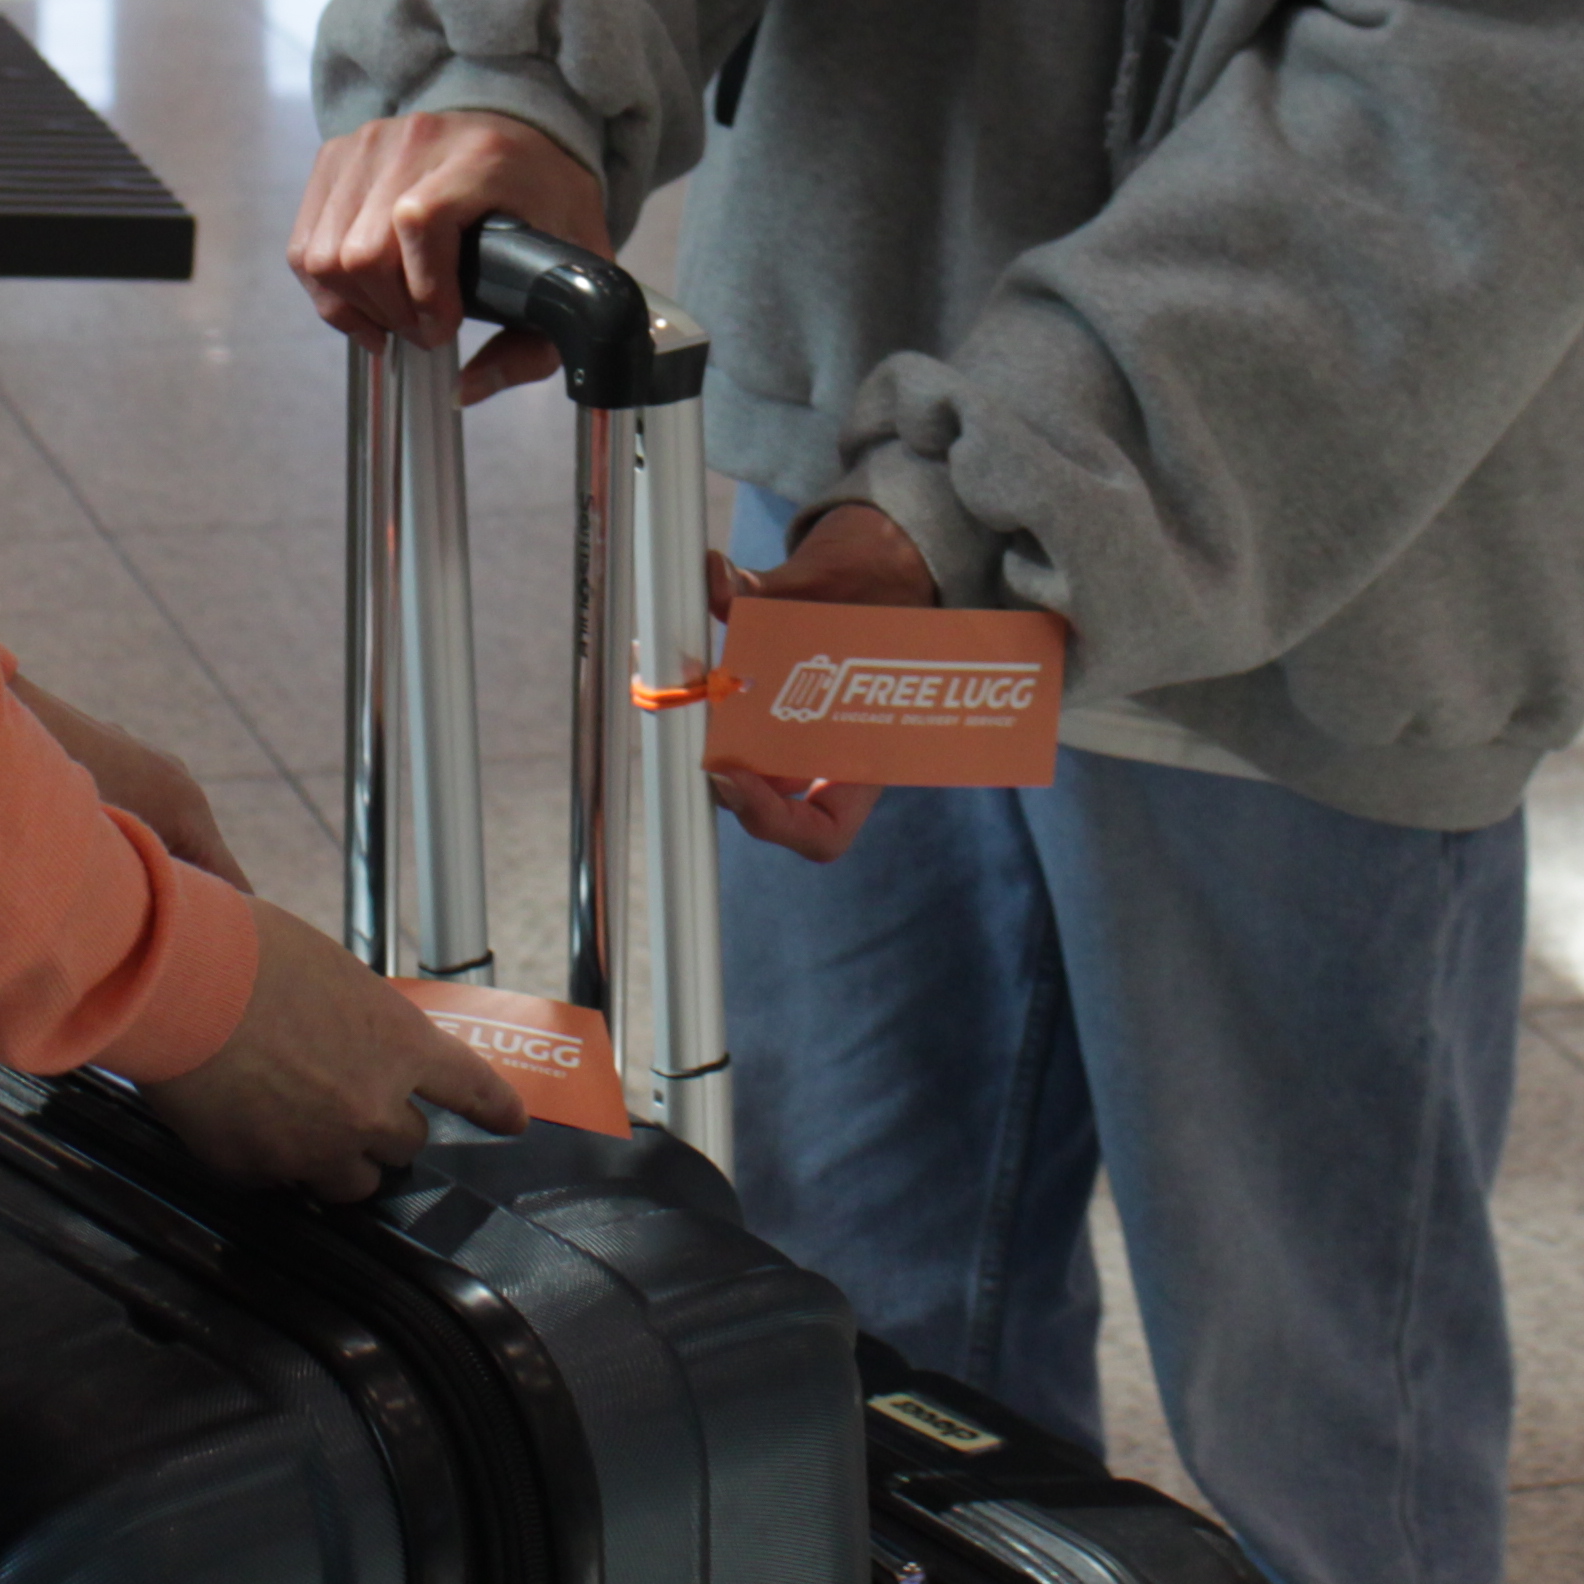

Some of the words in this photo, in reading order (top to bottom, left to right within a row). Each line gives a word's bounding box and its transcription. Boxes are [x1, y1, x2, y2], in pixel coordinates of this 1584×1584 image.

[841, 673, 943, 708] FREE
[943, 677, 1037, 710] LUGG
[467, 1025, 582, 1068] LUGG
